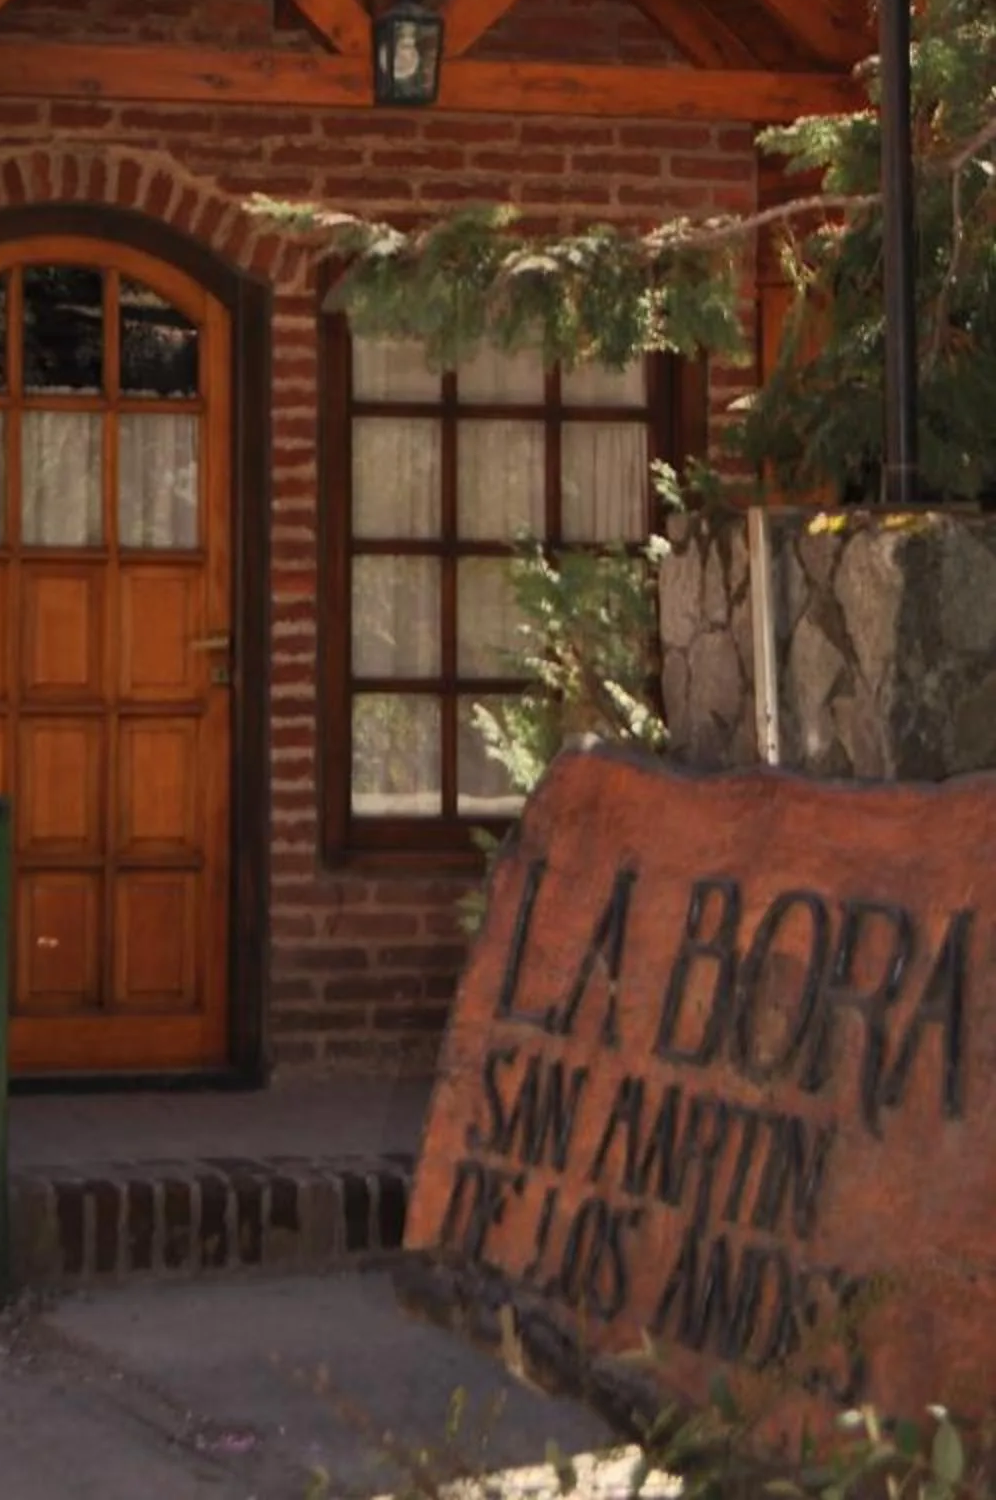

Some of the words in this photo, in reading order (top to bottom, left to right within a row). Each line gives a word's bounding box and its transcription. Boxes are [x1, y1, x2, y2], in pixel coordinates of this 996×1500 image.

[496, 855, 638, 1050] LA
[653, 874, 974, 1140] BORA
[466, 1047, 590, 1173] SAN
